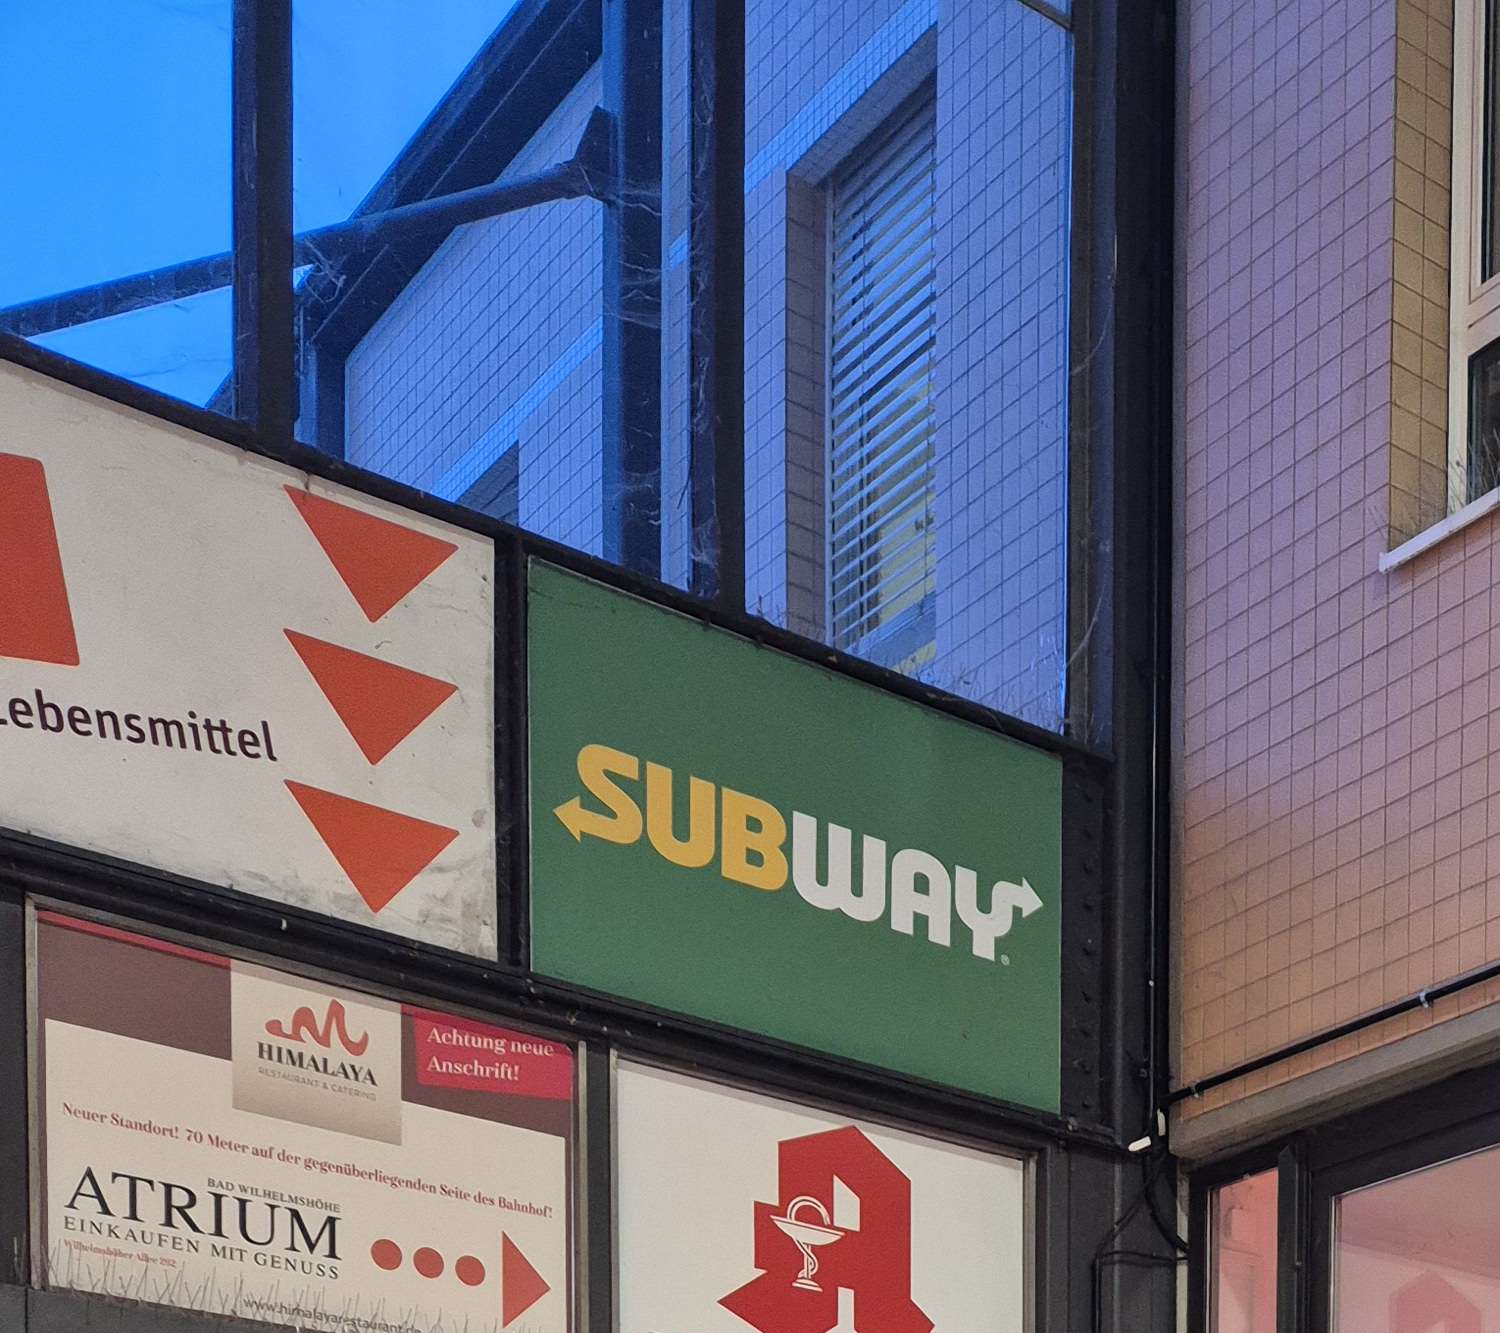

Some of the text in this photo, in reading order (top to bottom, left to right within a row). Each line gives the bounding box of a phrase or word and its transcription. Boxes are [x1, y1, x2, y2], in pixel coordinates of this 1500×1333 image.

[0, 688, 278, 762] ebensmittel
[552, 743, 1044, 962] SUBWAY
[257, 1041, 378, 1086] HIMALAYA
[426, 1027, 554, 1057] Achtung neue
[427, 1055, 520, 1081] Anschrift!
[258, 1067, 320, 1089] RESTAURANT
[331, 1083, 377, 1102] CATERING
[63, 1102, 553, 1219] Neuer Standort! 70 Meter auf der gegenüberliegenden Seite des Bahnhof!
[64, 1166, 342, 1260] ATRIUM
[207, 1177, 341, 1213] BAD WILHELMSHÖHE
[64, 1215, 339, 1280] EINKAUFEN MIT GENUSS
